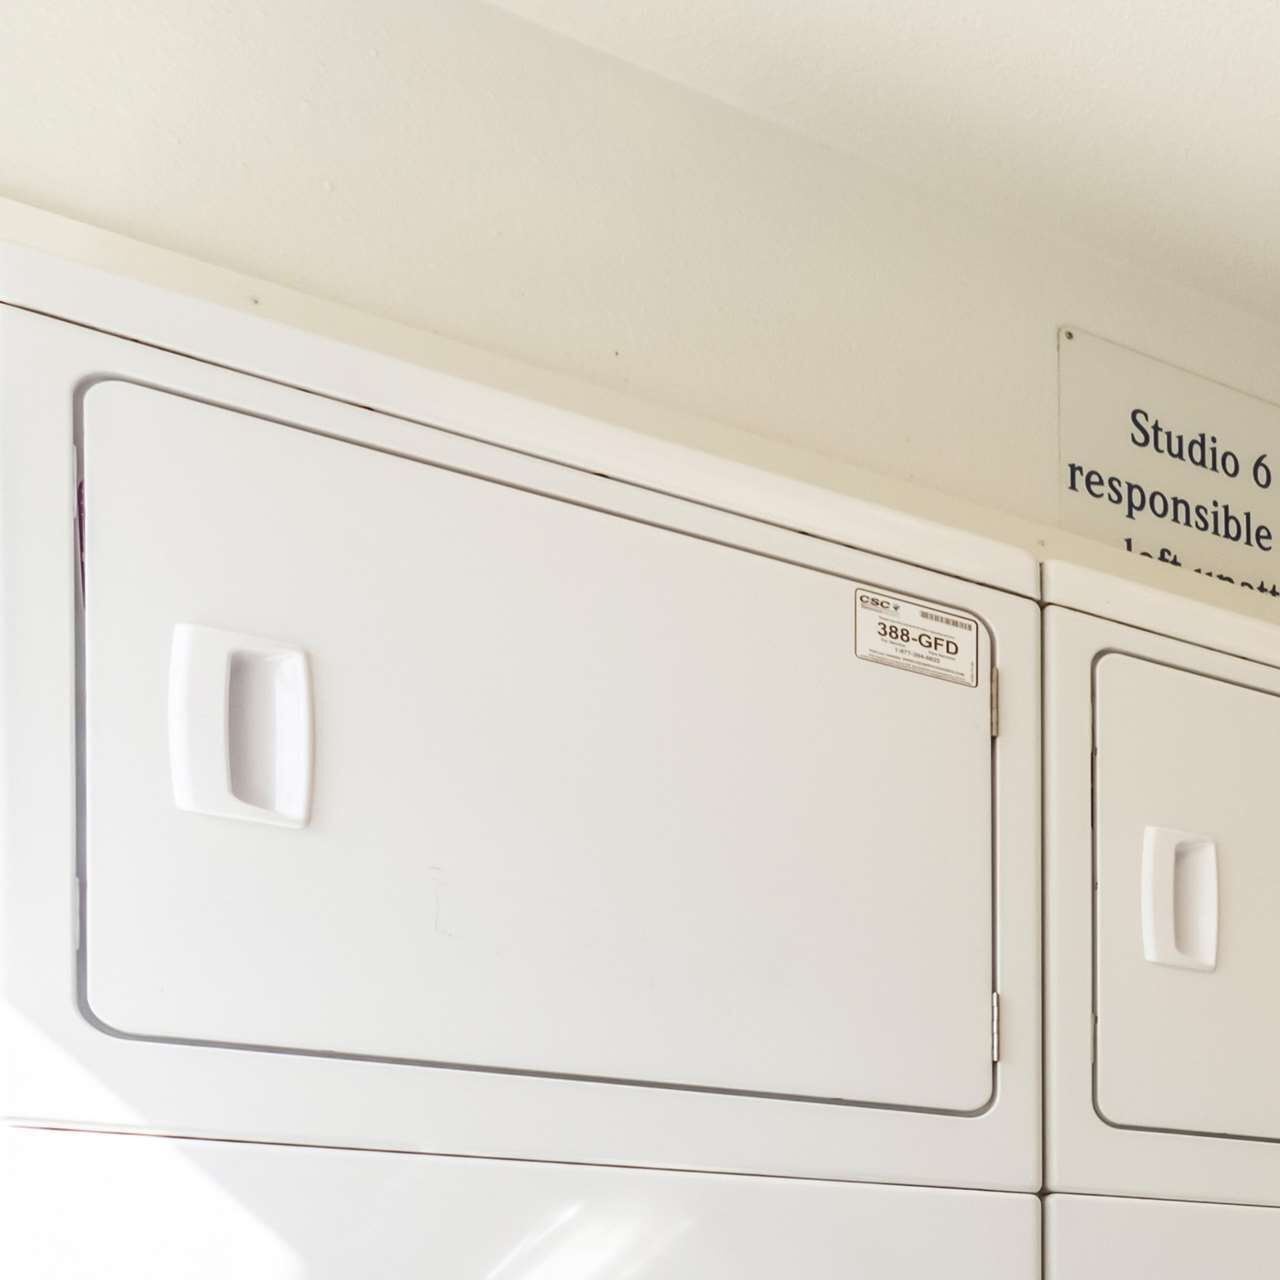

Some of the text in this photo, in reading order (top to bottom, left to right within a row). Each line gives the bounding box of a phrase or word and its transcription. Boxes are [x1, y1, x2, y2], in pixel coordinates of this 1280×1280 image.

[1129, 407, 1240, 479] Studio
[1251, 453, 1272, 489] 6
[1067, 462, 1273, 552] responsible
[859, 594, 891, 609] CSC
[877, 621, 959, 655] 388-GFD
